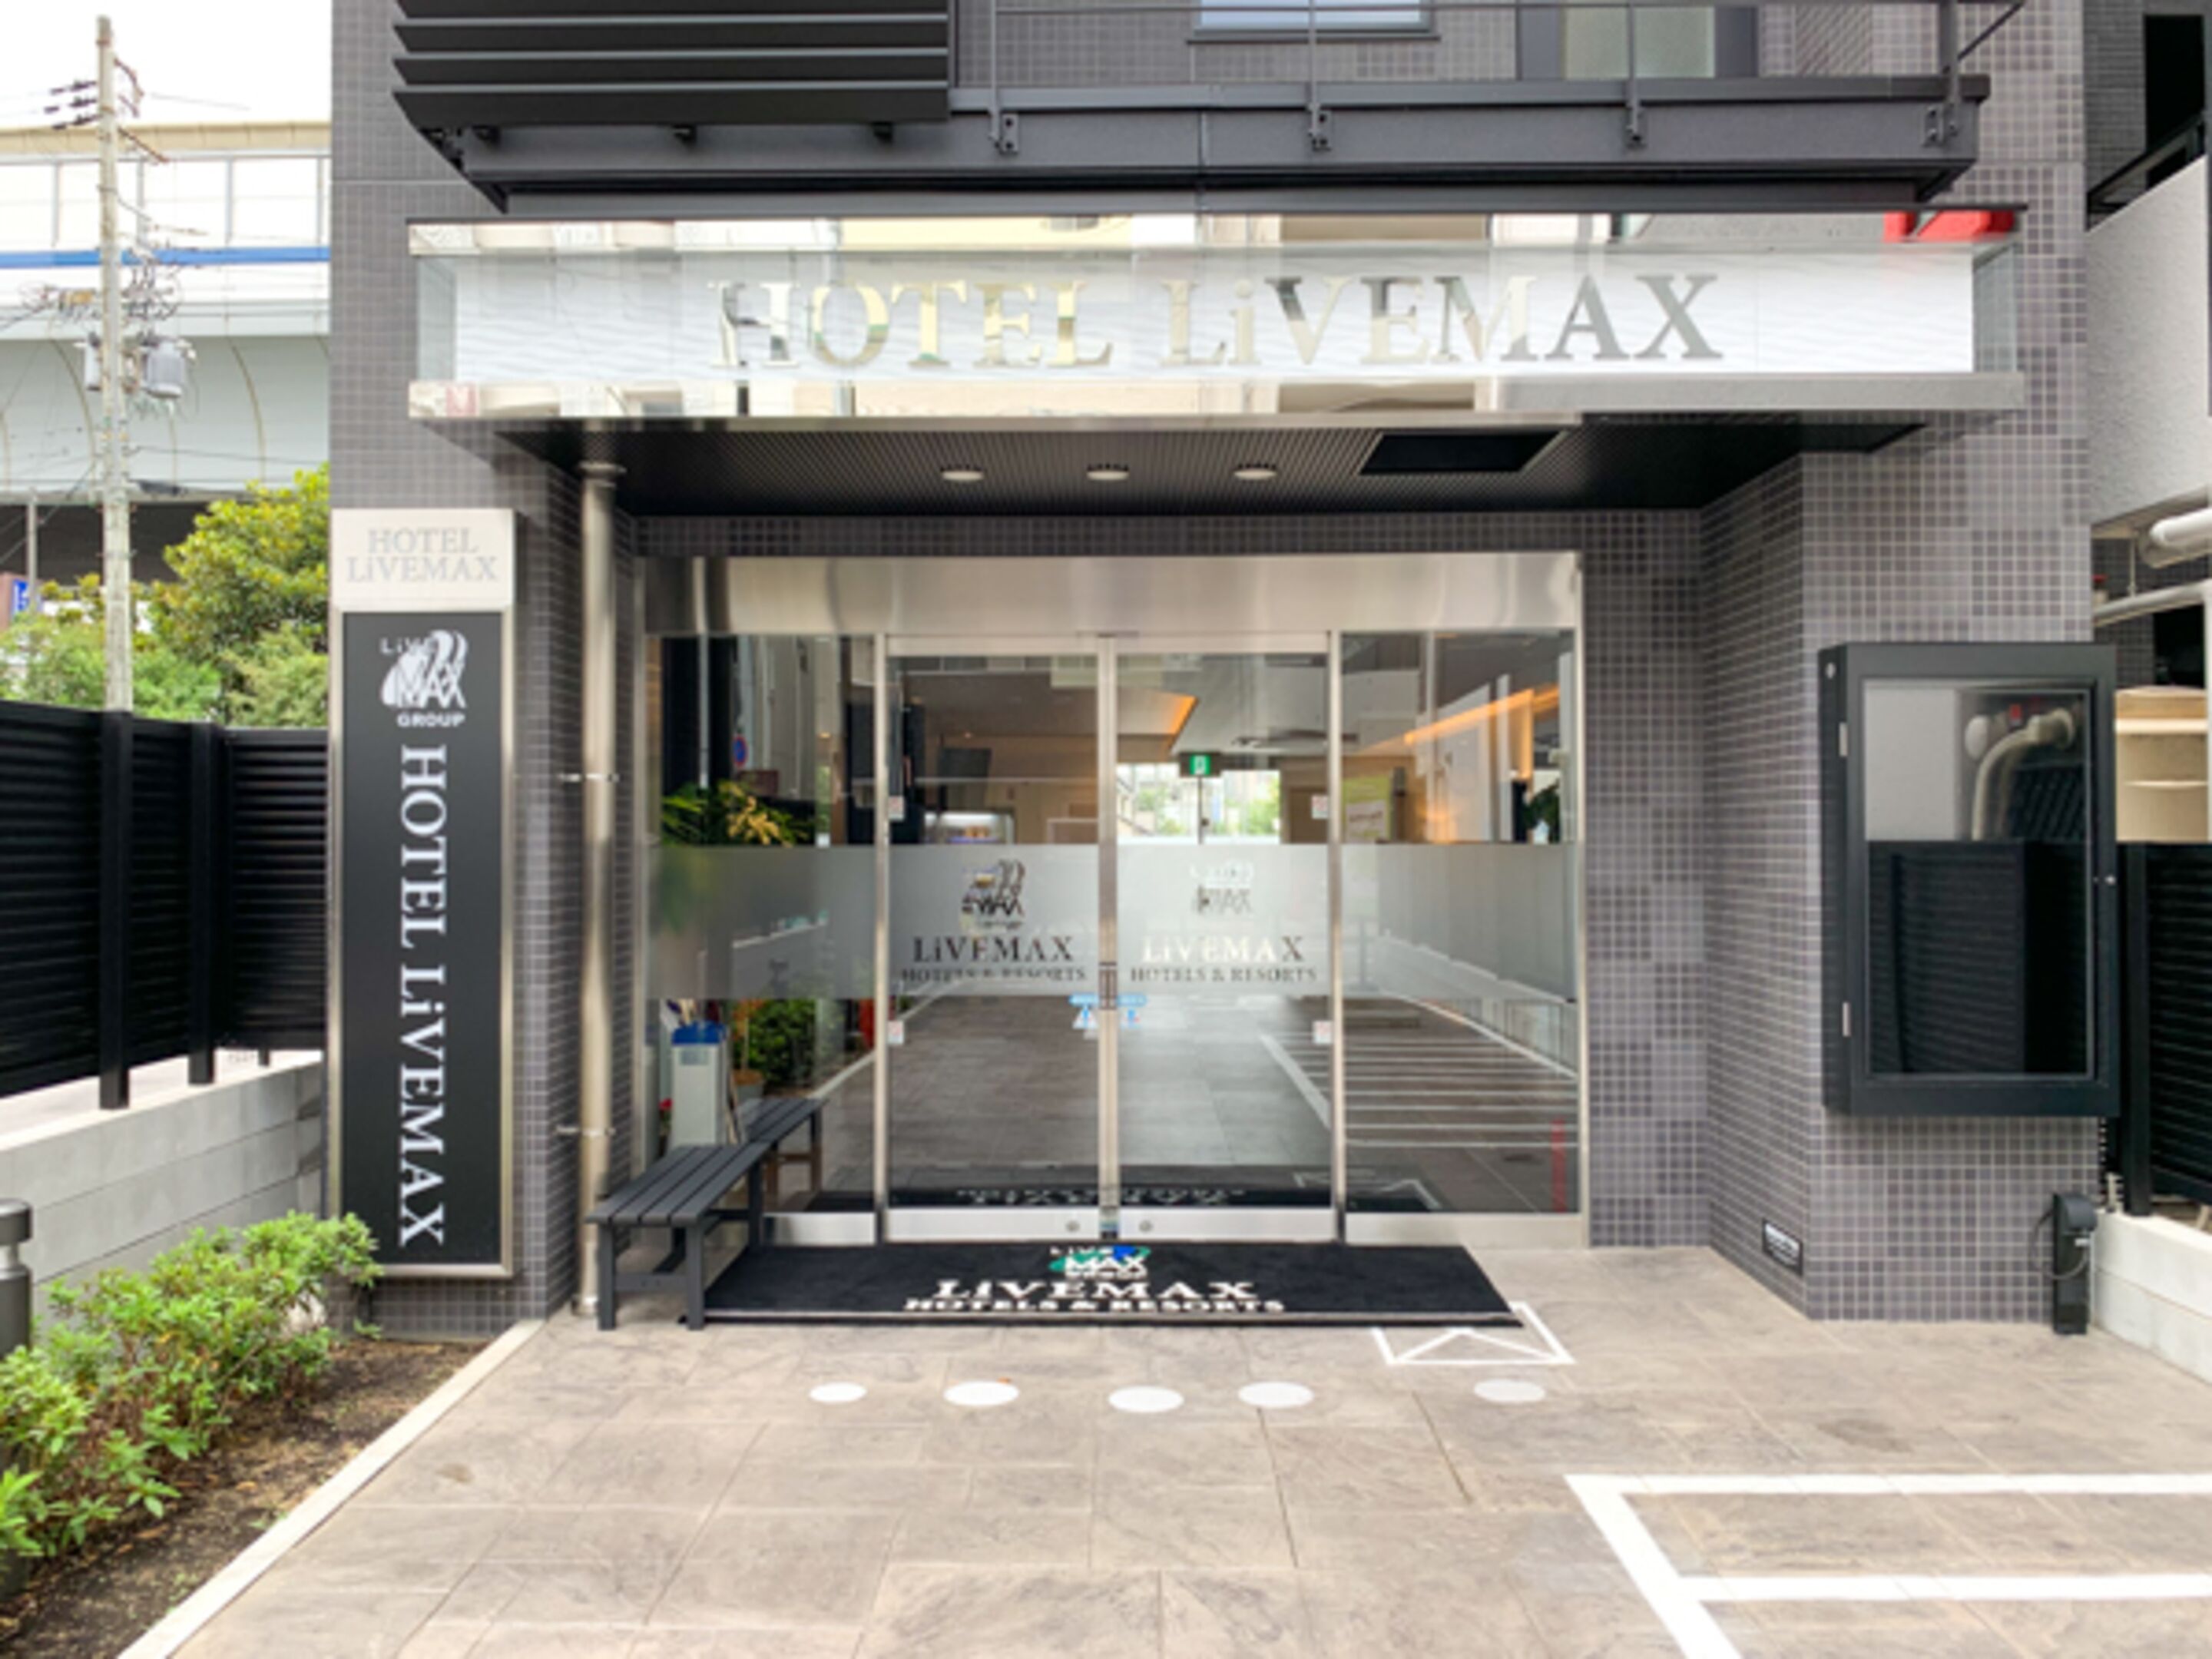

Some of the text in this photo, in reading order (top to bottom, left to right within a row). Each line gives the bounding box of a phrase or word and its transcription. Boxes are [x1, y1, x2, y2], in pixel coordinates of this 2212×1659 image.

[708, 273, 1723, 368] HOTEL LiVEMAX
[367, 526, 479, 555] HOTEL
[346, 555, 498, 582] LiVEMAX
[396, 713, 465, 727] GROUP
[912, 935, 1074, 962] LiVEMAX
[1131, 967, 1207, 982] HOTELS
[1230, 967, 1318, 982] RESORTS
[399, 743, 447, 1246] HOTEL LiVEMAX
